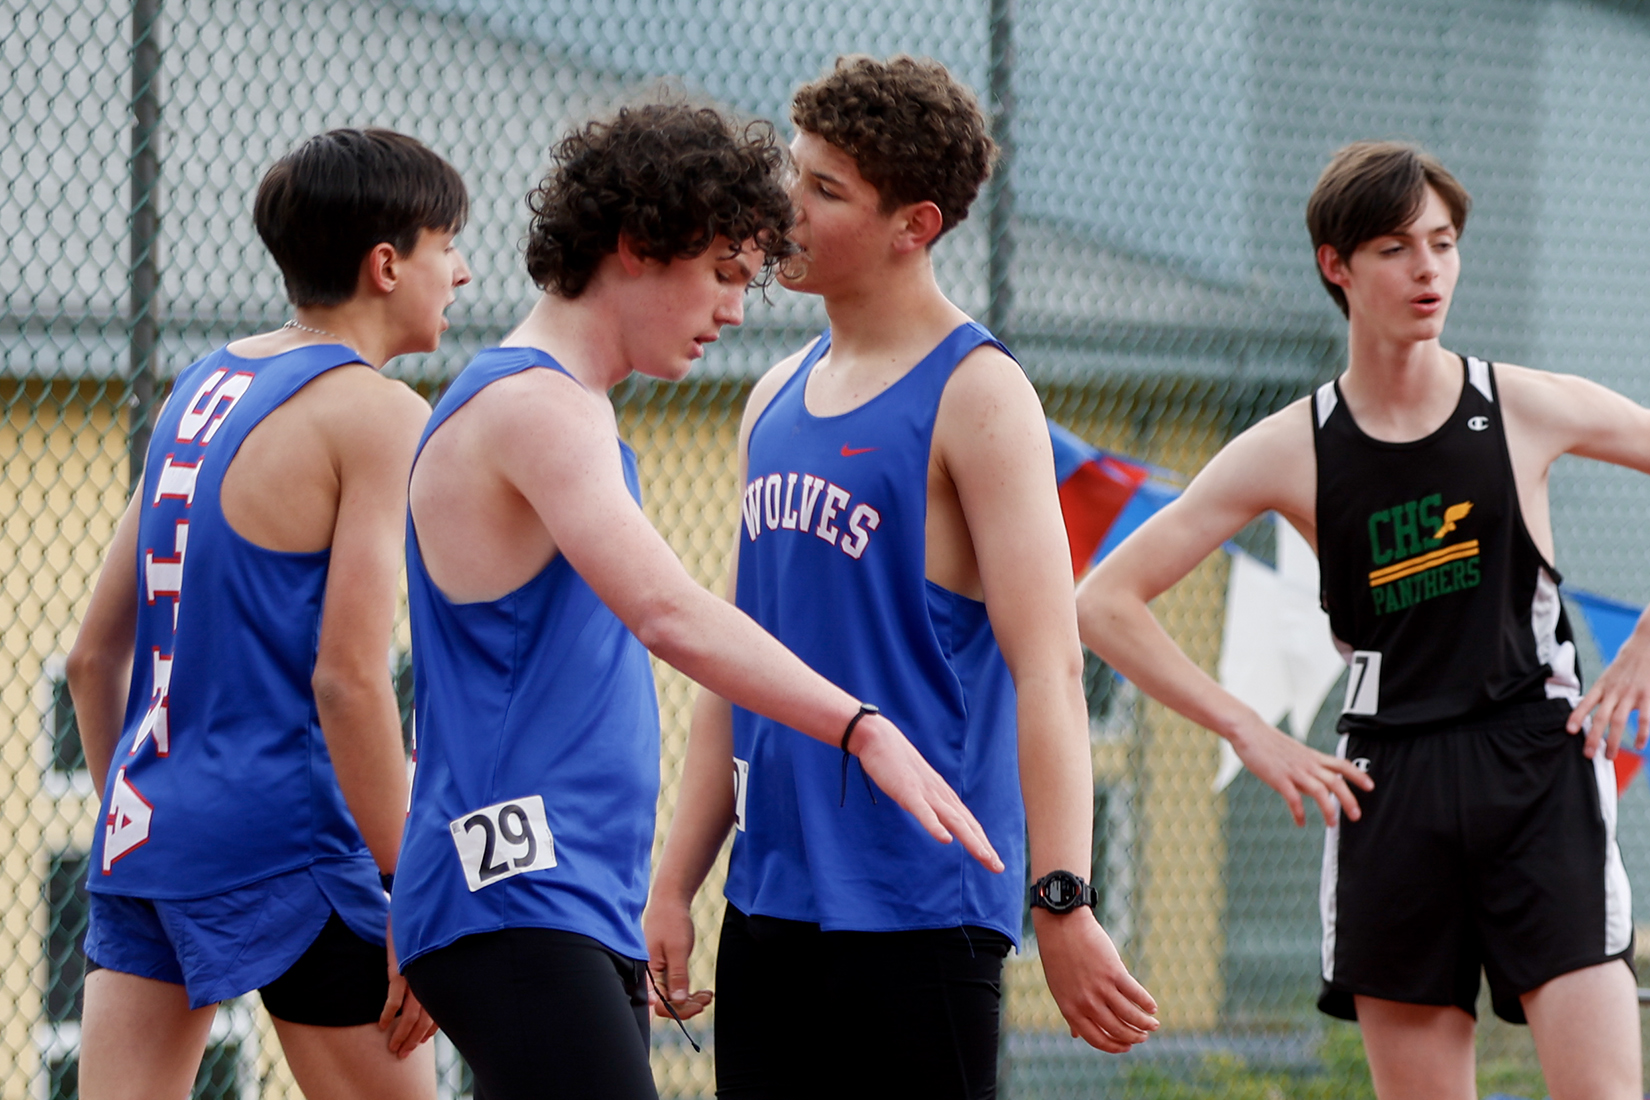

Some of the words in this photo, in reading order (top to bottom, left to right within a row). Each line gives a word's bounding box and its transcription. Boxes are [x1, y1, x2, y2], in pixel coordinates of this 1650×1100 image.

[743, 472, 881, 560] WOLVES
[1368, 492, 1444, 566] CHS
[1371, 556, 1481, 616] PANTHERS
[1350, 656, 1369, 709] 7
[463, 804, 537, 882] 29
